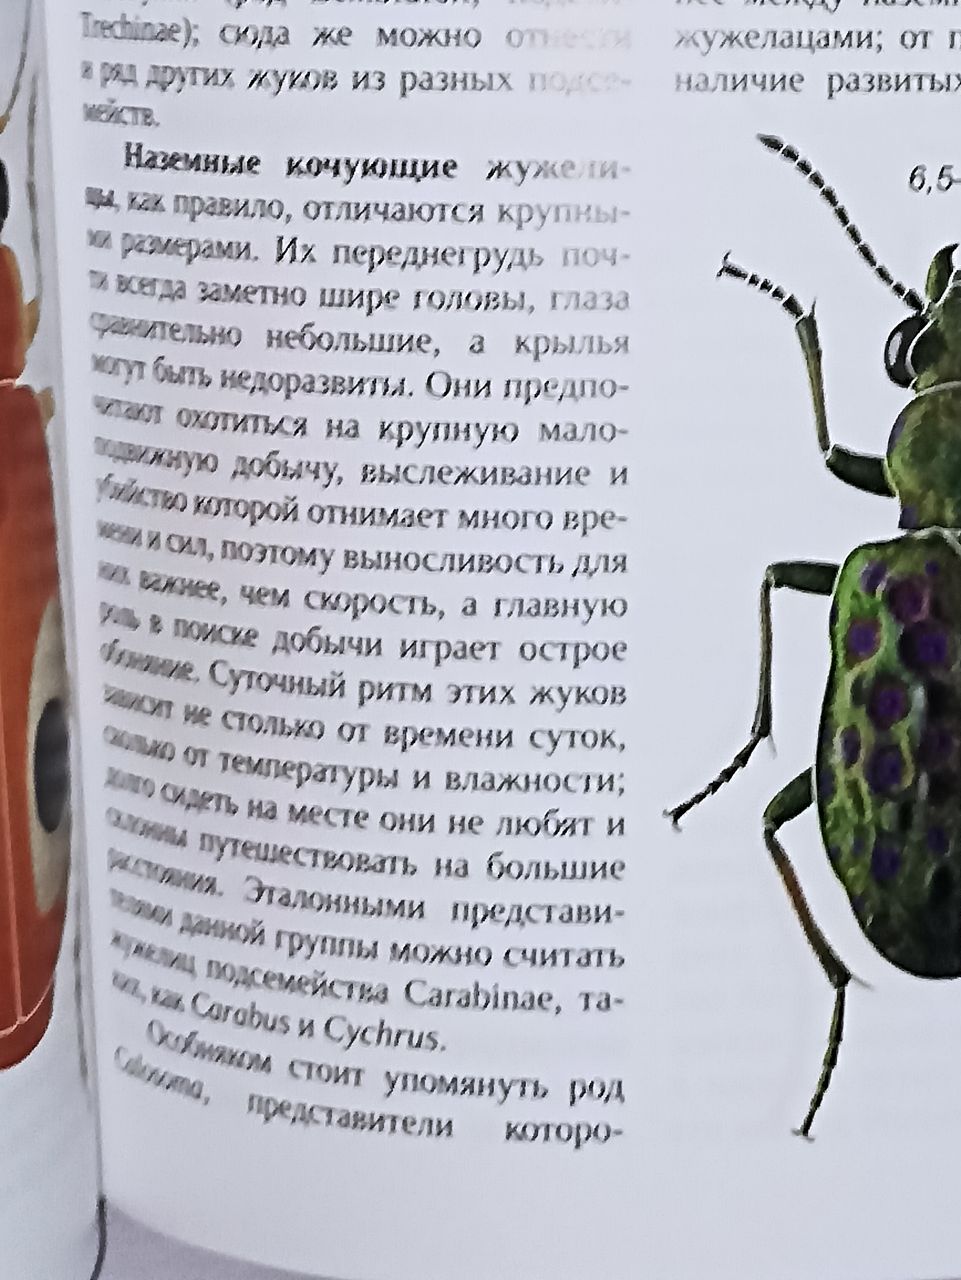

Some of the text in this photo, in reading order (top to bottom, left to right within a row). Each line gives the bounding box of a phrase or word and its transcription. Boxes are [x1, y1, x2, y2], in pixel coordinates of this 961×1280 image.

[674, 28, 883, 57] жужелацами;
[899, 28, 934, 51] от
[675, 71, 806, 93] наличие
[123, 139, 459, 186] Наземные кочующие
[302, 198, 485, 224] отличаются
[497, 202, 631, 231] крупны-
[265, 320, 630, 363] небольшие, а крылья
[219, 367, 414, 402] недоразвиты.
[424, 369, 492, 400] Они
[502, 377, 630, 407] предпо-
[229, 448, 629, 490] добычу, выслеживание и
[172, 617, 628, 670] поиске добычи играет острое
[220, 708, 626, 758] столько от времени суток,
[182, 744, 626, 798] от температуры и влажности;
[198, 831, 419, 877] путешествовать
[433, 855, 470, 880] на
[485, 850, 627, 882] большие
[243, 873, 626, 932] Эталонными представи-
[205, 958, 625, 1016] подсемейства Carabinae, та-
[297, 1016, 315, 1040] и
[323, 1013, 447, 1053] Cychrus.
[287, 1058, 366, 1088] стоит
[383, 1069, 550, 1106] упомянуть
[568, 1077, 626, 1108] род
[246, 1092, 624, 1151] представители которо-
